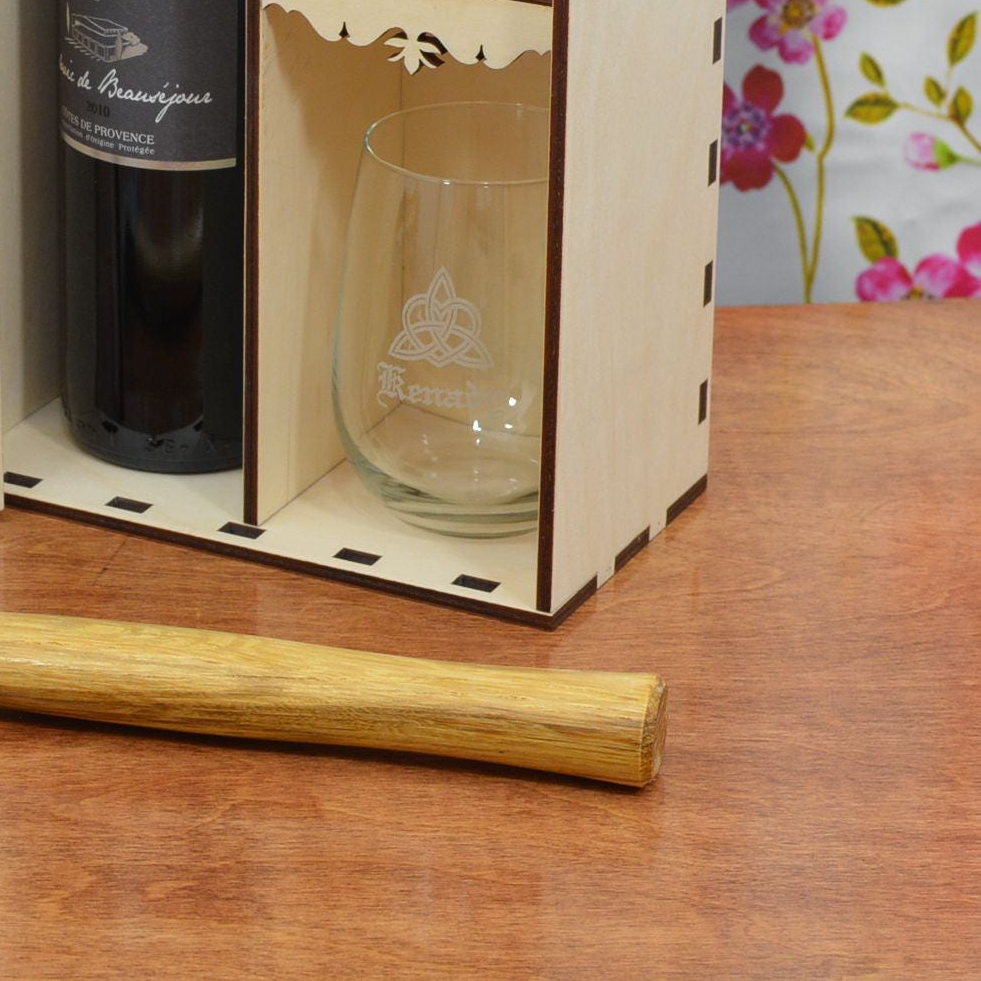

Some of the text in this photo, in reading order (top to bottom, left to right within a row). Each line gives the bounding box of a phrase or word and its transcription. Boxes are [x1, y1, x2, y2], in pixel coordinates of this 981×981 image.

[77, 70, 92, 90] de
[86, 100, 110, 118] 2010
[80, 118, 93, 133] DE
[94, 124, 155, 145] PROVENCE
